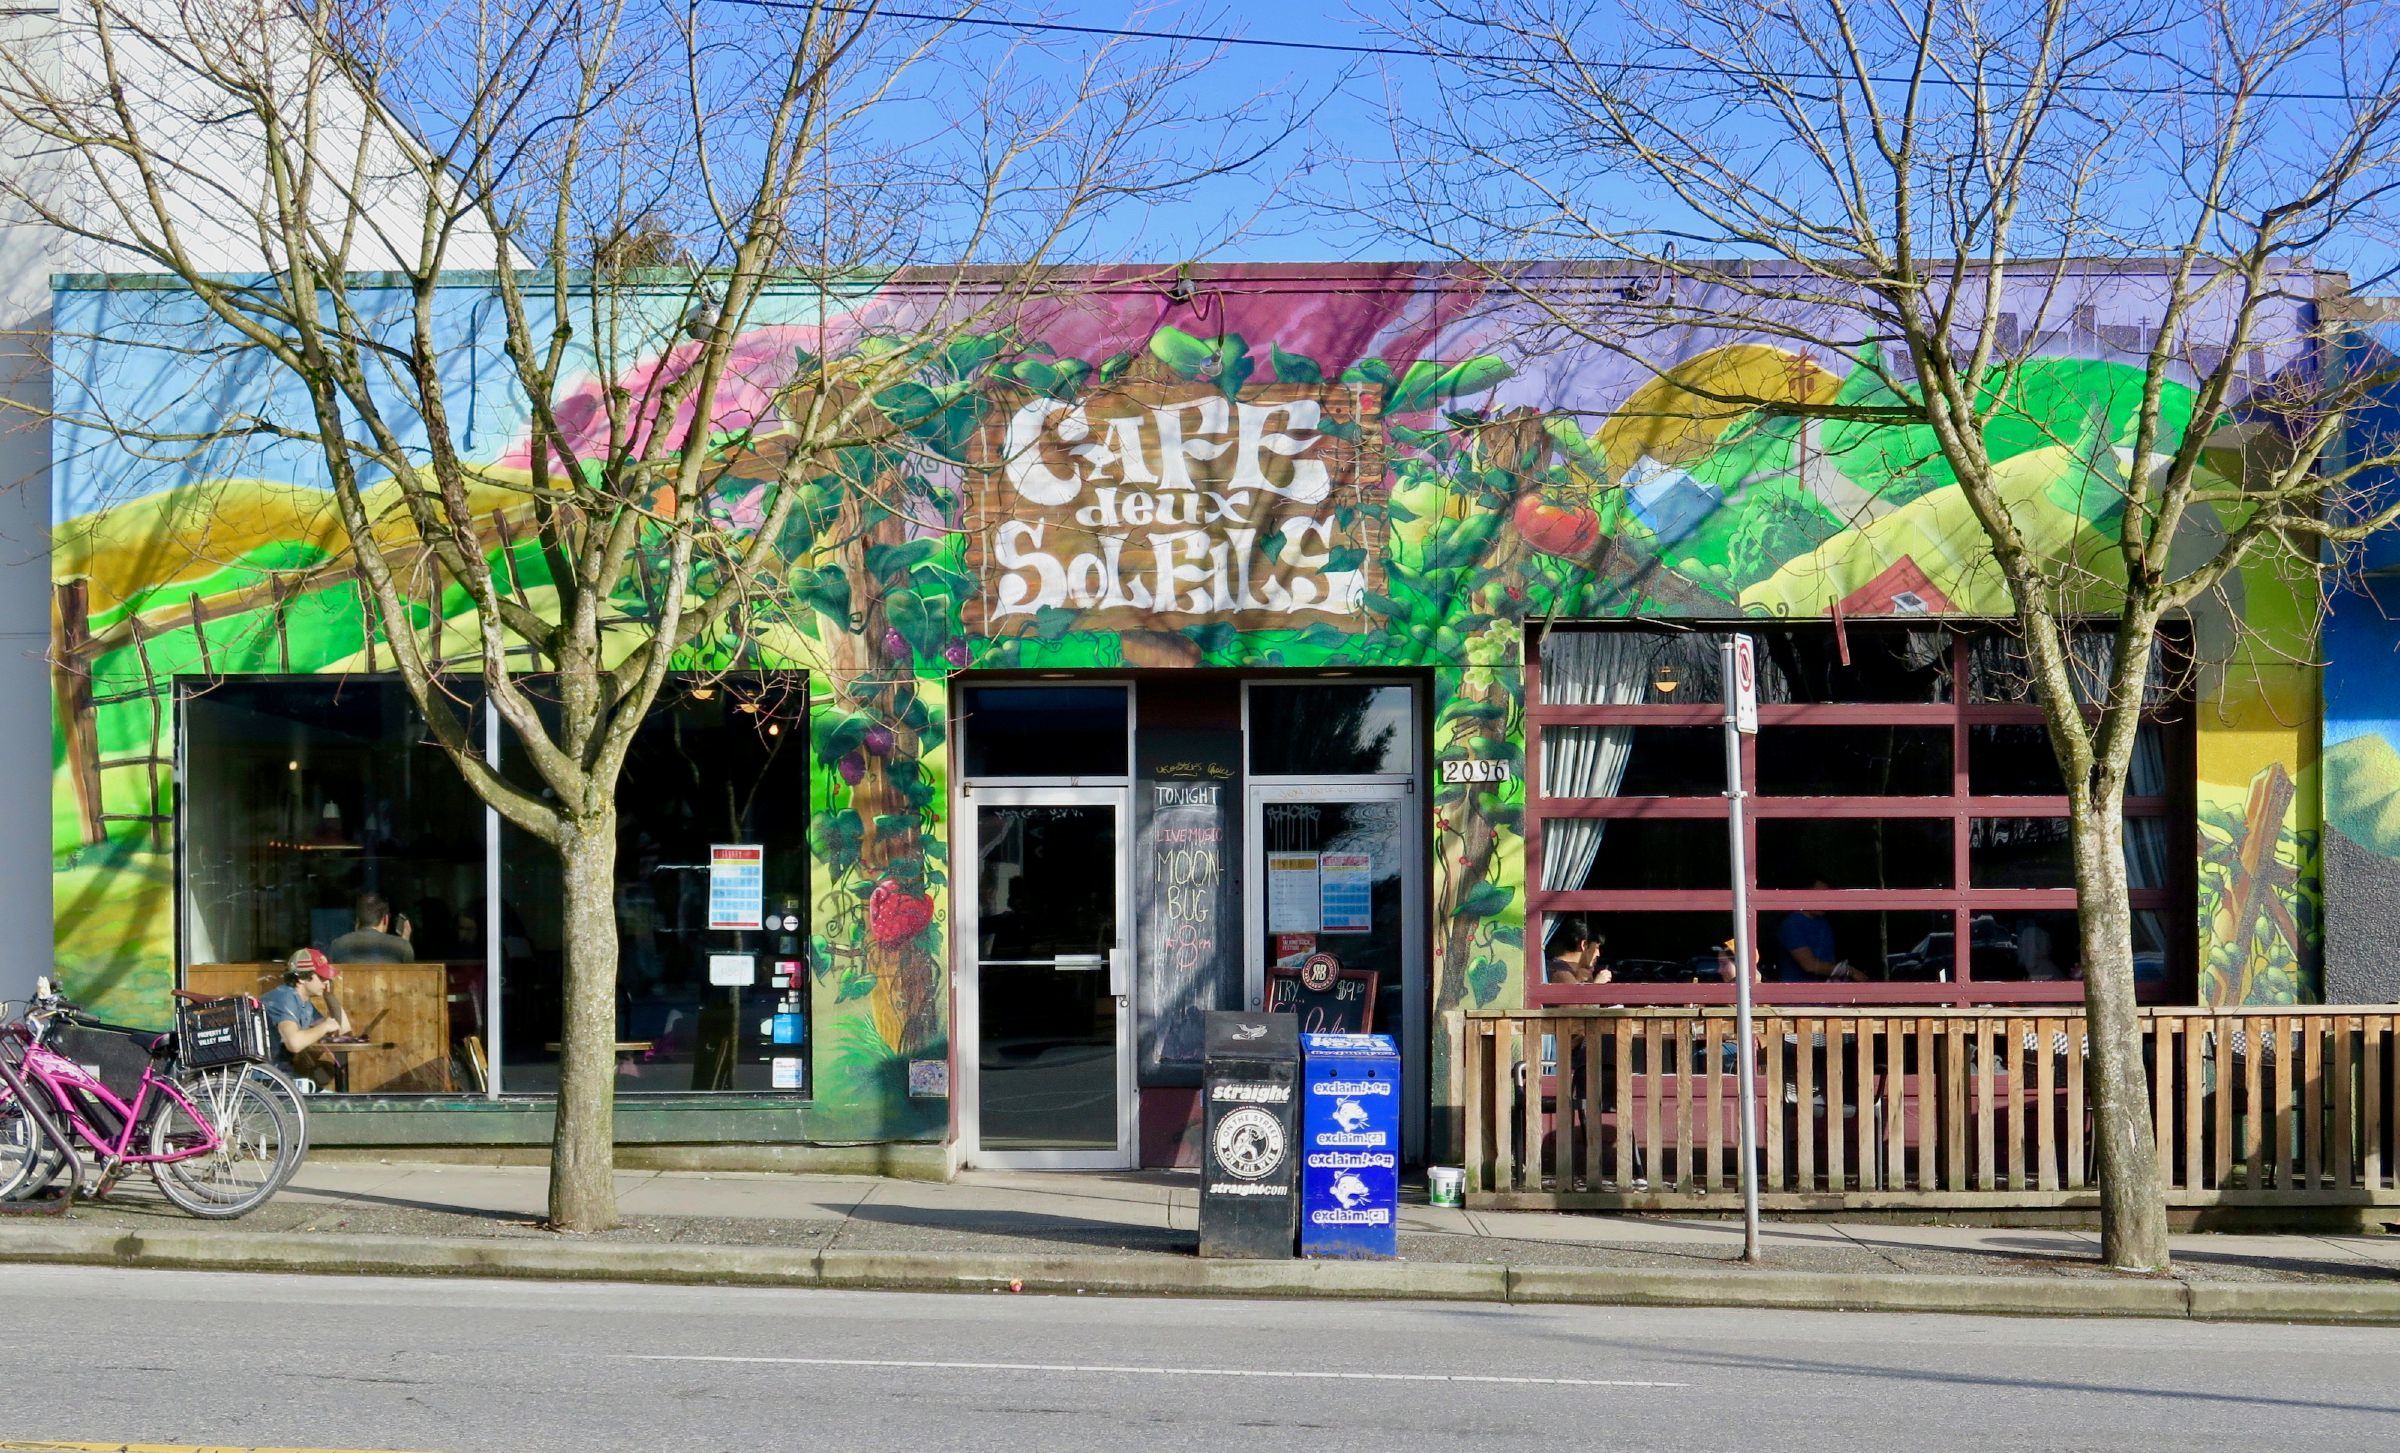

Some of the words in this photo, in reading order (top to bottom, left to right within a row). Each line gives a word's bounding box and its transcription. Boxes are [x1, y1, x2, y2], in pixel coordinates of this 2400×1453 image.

[1003, 396, 1331, 505] CAFE
[1075, 488, 1252, 527] deux
[1446, 760, 1505, 781] 2096
[1155, 786, 1221, 806] TONIGHT
[1155, 828, 1187, 843] LIVE
[1187, 827, 1224, 843] MUSIC
[1167, 885, 1209, 923] BUG
[1176, 924, 1199, 969] 8
[1212, 1084, 1291, 1103] straight
[1232, 1114, 1249, 1127] THE
[1254, 1115, 1281, 1141] STREET
